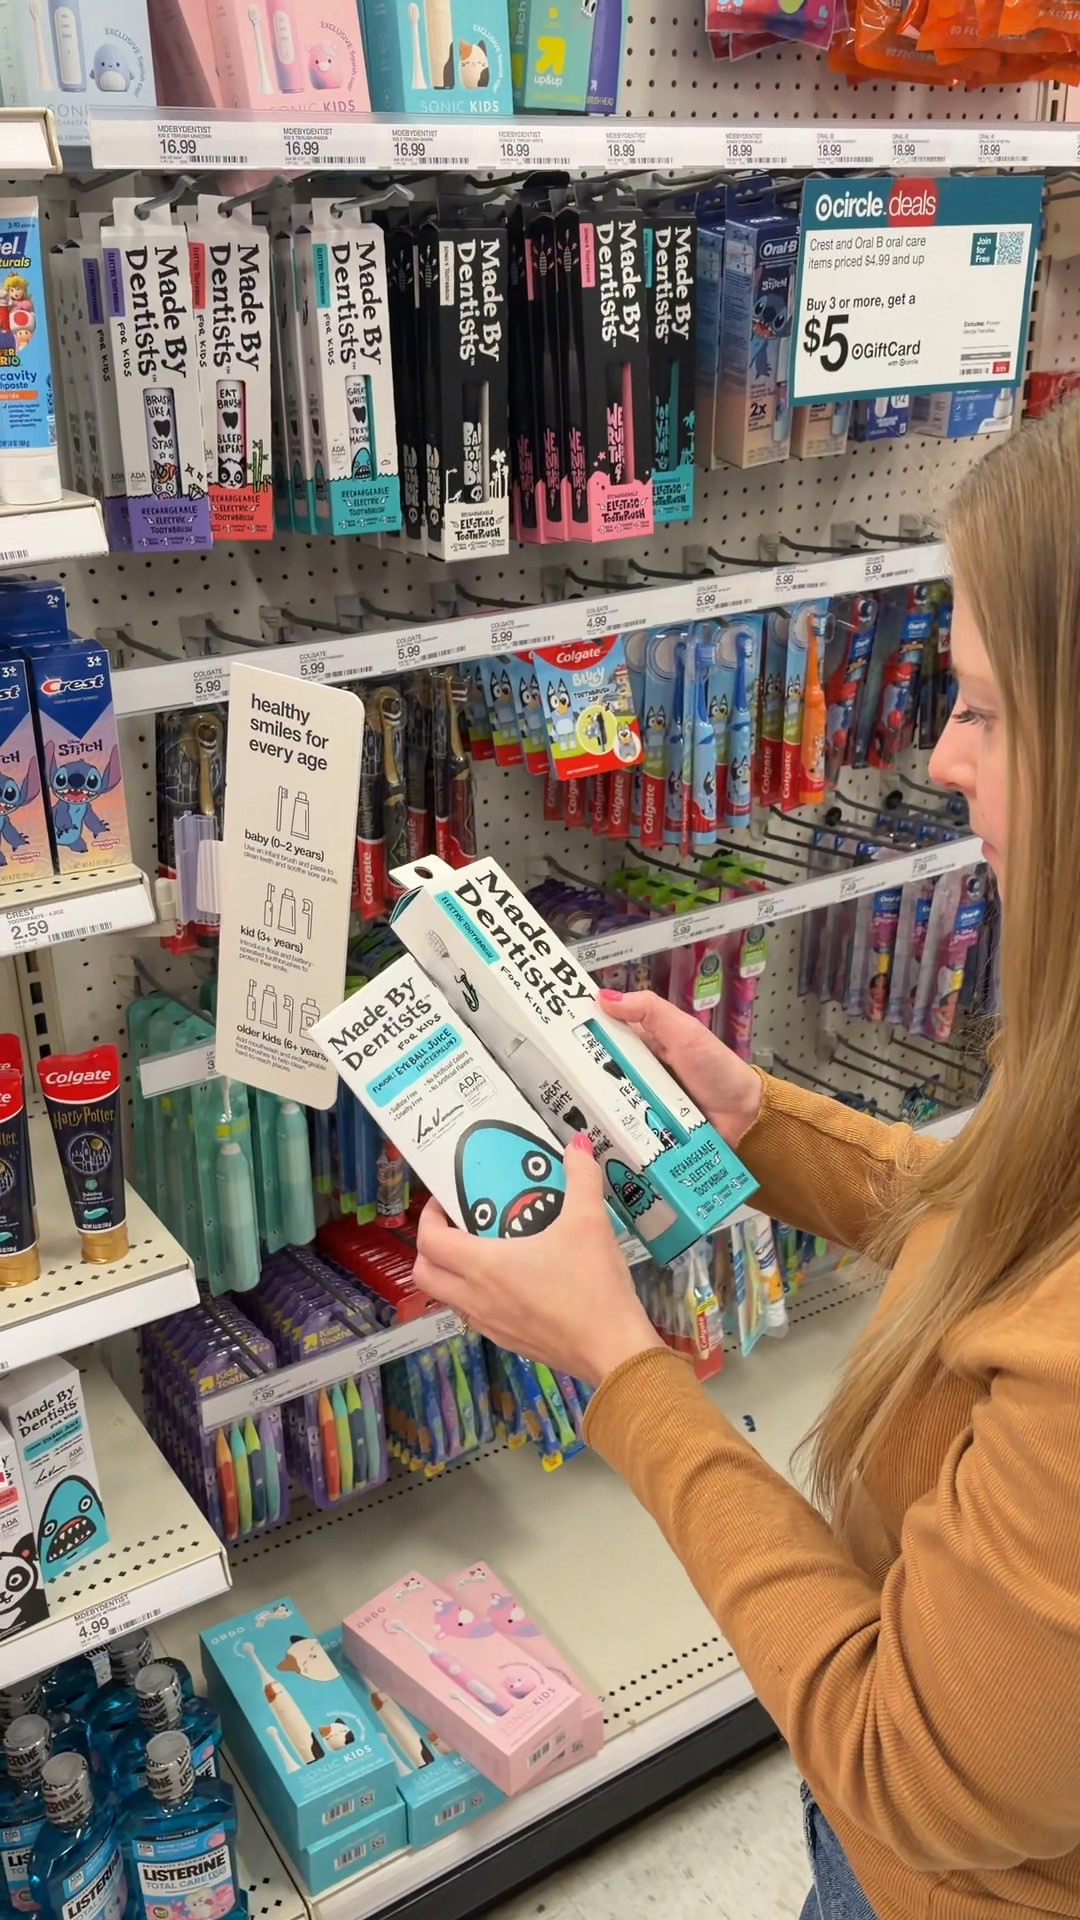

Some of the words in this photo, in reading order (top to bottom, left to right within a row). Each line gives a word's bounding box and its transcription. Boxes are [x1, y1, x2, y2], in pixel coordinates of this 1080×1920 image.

[534, 75, 562, 87] up&up
[420, 101, 464, 113] SONIC
[470, 100, 499, 113] KIDS
[160, 140, 196, 154] 16.99
[285, 142, 319, 156] 16.99
[393, 143, 426, 157] 16.99
[500, 144, 530, 157] 18.99
[607, 144, 635, 157] 18.99
[727, 145, 752, 157] 18.99
[817, 145, 841, 157] 18.99
[892, 145, 915, 157] 18.99
[979, 144, 1000, 156] 18.99
[888, 190, 936, 216] deals
[763, 240, 798, 256] Oral-B
[810, 237, 834, 252] Crest
[836, 237, 853, 251] and
[855, 236, 874, 250] Oral
[876, 236, 884, 249] B
[886, 235, 903, 249] oral
[905, 237, 927, 248] care
[976, 237, 992, 246] Join
[976, 247, 986, 255] for
[618, 220, 642, 299] Made
[675, 226, 694, 300] Made
[808, 256, 832, 270] items
[834, 254, 862, 271] priced
[864, 254, 890, 267] $4.99
[892, 253, 910, 266] and
[912, 255, 925, 268] up
[975, 254, 991, 264] Free
[154, 245, 187, 330] Made
[237, 244, 264, 325] Made
[355, 241, 382, 320] Made
[481, 239, 504, 318] Made
[806, 298, 827, 313] Buy
[829, 297, 837, 310] 3
[839, 299, 850, 309] or
[853, 296, 885, 309] more,
[887, 294, 906, 309] get
[908, 296, 916, 305] a
[197, 315, 206, 337] FOR
[620, 302, 641, 343] By
[672, 302, 692, 341] By
[117, 322, 127, 345] FOR
[123, 349, 132, 378] KIDS
[323, 313, 331, 334] FOR
[327, 338, 335, 366] KIDS
[360, 325, 383, 365] By
[478, 322, 502, 362] By
[803, 314, 849, 372] $5
[864, 340, 921, 358] GiftCard
[161, 335, 188, 379] By
[198, 339, 207, 368] KIDS
[235, 331, 262, 372] By
[217, 399, 242, 410] BRUSH
[220, 389, 237, 399] EAT
[750, 403, 767, 417] 2x
[152, 438, 174, 450] STAR
[460, 516, 495, 530] ELECTRIC
[455, 528, 500, 541] TOOTHBRUSH
[775, 574, 794, 586] 5.99
[865, 564, 882, 576] 5.99
[47, 594, 60, 605] 2+
[697, 594, 716, 607] 5.99
[586, 616, 607, 628] 4.99
[396, 634, 422, 644] COLGATE
[491, 631, 513, 644] 5.99
[87, 656, 102, 667] 3+
[300, 651, 327, 660] COLGATE
[398, 645, 420, 660] 5.99
[556, 647, 601, 664] Colgate
[2, 666, 17, 678] 3+
[193, 668, 222, 679] COLGATE
[301, 661, 325, 676] 5.99
[41, 675, 104, 696] Crest
[195, 680, 221, 694] 5.99
[251, 693, 311, 726] healthy
[250, 718, 301, 742] smiles
[305, 730, 329, 750] for
[249, 739, 294, 764] every
[297, 752, 328, 771] age
[762, 746, 772, 795] Colgate
[782, 751, 793, 800] Colgate
[611, 774, 624, 826] Colgate
[644, 783, 656, 834] Colgate
[245, 828, 269, 846] baby
[294, 846, 325, 862] years)
[243, 843, 256, 852] Use
[256, 847, 264, 855] an
[264, 849, 280, 860] infant
[281, 854, 298, 865] brush
[298, 860, 309, 869] and
[310, 862, 327, 874] paste
[327, 868, 334, 876] to
[362, 851, 373, 904] Colgate
[5, 908, 35, 920] CREST
[11, 919, 49, 941] 2.59
[240, 924, 255, 938] kid
[257, 929, 272, 943] (3+
[274, 937, 304, 954] years)
[442, 896, 464, 923] ELECTRIC
[462, 920, 494, 960] TOOTHBRUSH
[475, 869, 552, 957] Made
[550, 957, 596, 1002] By
[500, 966, 521, 991] FOR
[525, 992, 551, 1025] KIDS
[328, 1002, 385, 1055] Made
[384, 975, 415, 1013] By
[236, 1024, 261, 1039] older
[262, 1031, 282, 1046] kids
[283, 1037, 298, 1051] (6+
[397, 1030, 419, 1051] FOR
[419, 1013, 442, 1037] KIDS
[236, 1035, 248, 1044] Add
[248, 1038, 280, 1054] mouthwash
[280, 1049, 291, 1059] and
[291, 1053, 326, 1071] rechargeable
[372, 1072, 397, 1094] FLAVOR:
[428, 1028, 452, 1051] JUICE
[45, 1069, 112, 1085] Colgate
[426, 1077, 434, 1086] No
[433, 1060, 454, 1080] Artificial
[452, 1049, 469, 1065] Colors
[431, 1084, 439, 1092] No
[438, 1068, 458, 1087] Artificial
[456, 1056, 474, 1072] Flavors
[458, 1071, 483, 1093] ADA
[540, 1080, 563, 1105] GREAT
[391, 1098, 408, 1114] Sulfate
[406, 1090, 418, 1102] Free
[549, 1091, 572, 1116] WHITE
[53, 1107, 82, 1130] Harry
[84, 1106, 116, 1124] Potter
[669, 1139, 716, 1179] RECHARGEABLE
[689, 1160, 715, 1183] ELECTRIC
[359, 1349, 378, 1363] 1.99
[16, 1399, 55, 1427] Made
[56, 1385, 75, 1403] By
[69, 1446, 82, 1458] ADA
[79, 1617, 109, 1638] 4.99
[357, 1606, 386, 1628] ORDO
[211, 1626, 245, 1644] ORDO
[343, 1744, 373, 1764] KIDS
[155, 1833, 183, 1841] ALCOHOL
[143, 1852, 226, 1881] LISTERINE
[146, 1881, 177, 1890] TOTAL
[179, 1876, 205, 1888] CARE
